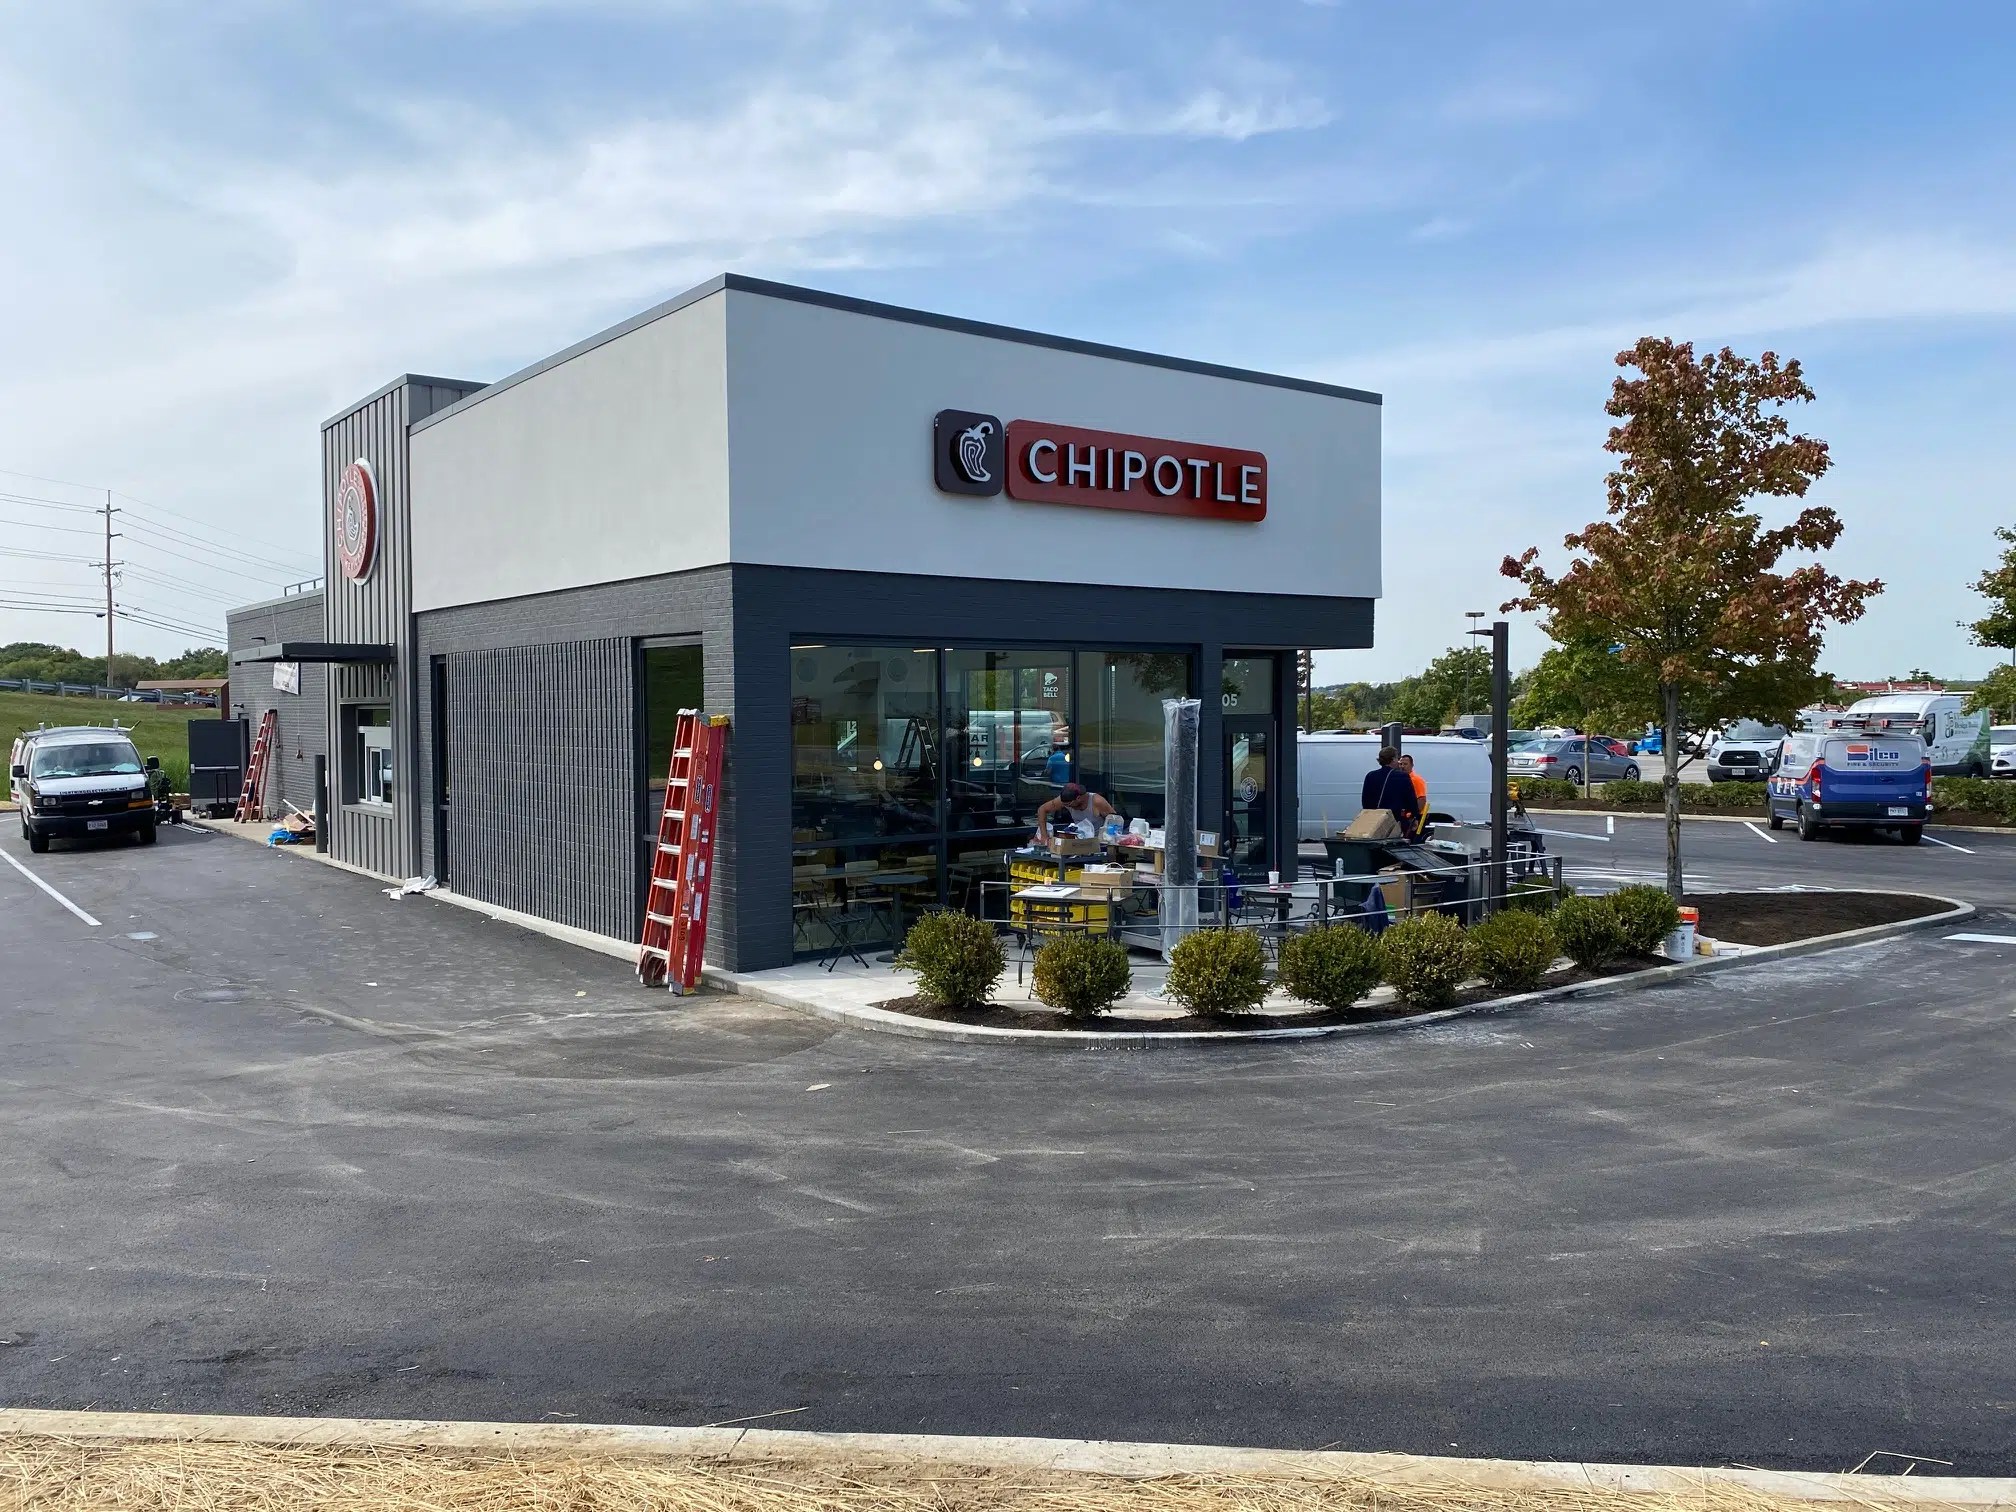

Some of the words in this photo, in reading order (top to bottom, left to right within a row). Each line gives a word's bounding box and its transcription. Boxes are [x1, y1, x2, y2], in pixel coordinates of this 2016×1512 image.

[1029, 438, 1262, 505] CHIPOTLE
[336, 469, 360, 548] CHIPOTLE
[1221, 693, 1238, 707] 05
